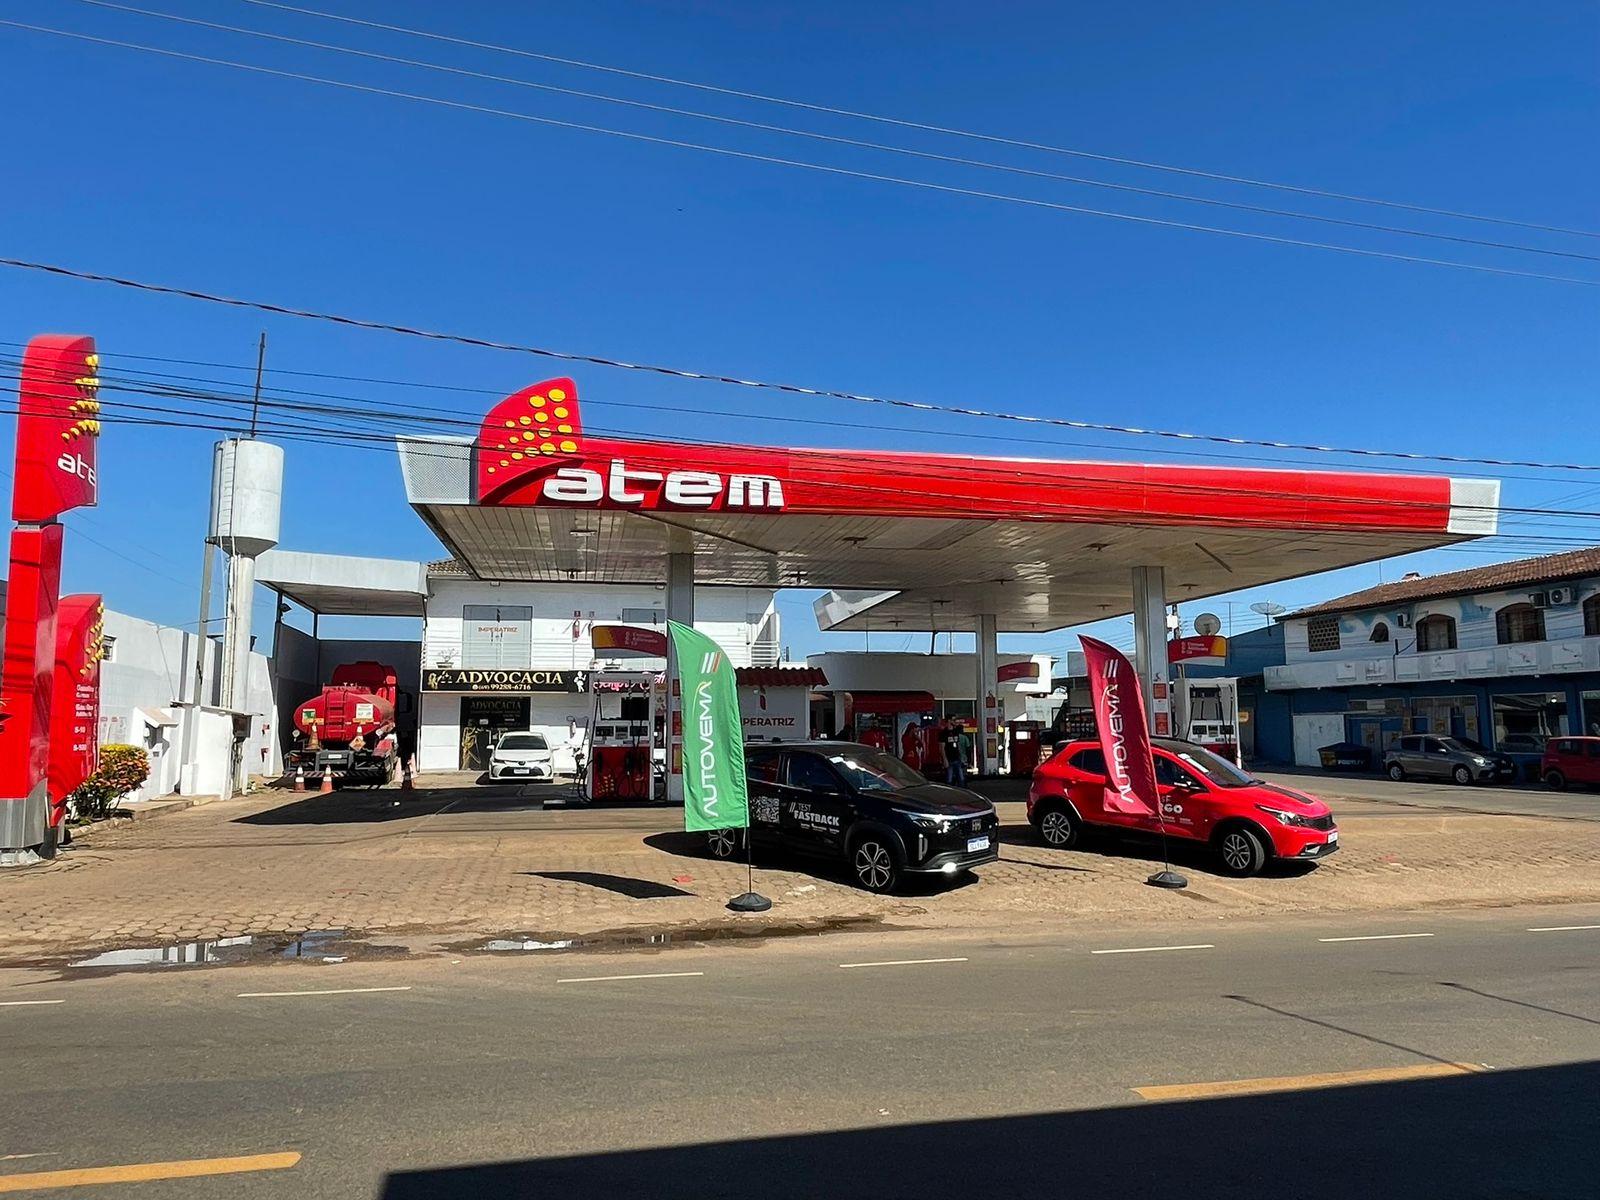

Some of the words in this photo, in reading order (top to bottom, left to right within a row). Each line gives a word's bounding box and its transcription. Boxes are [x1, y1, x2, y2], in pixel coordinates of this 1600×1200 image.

[543, 459, 785, 507] atem
[456, 671, 564, 684] ADVOCACIA
[471, 701, 521, 710] ADVOCACIA
[743, 717, 795, 726] PERATRIZ
[698, 681, 719, 817] AUTOVEMA
[1106, 685, 1134, 803] AUTOVEMA
[793, 810, 840, 827] FASTBACK
